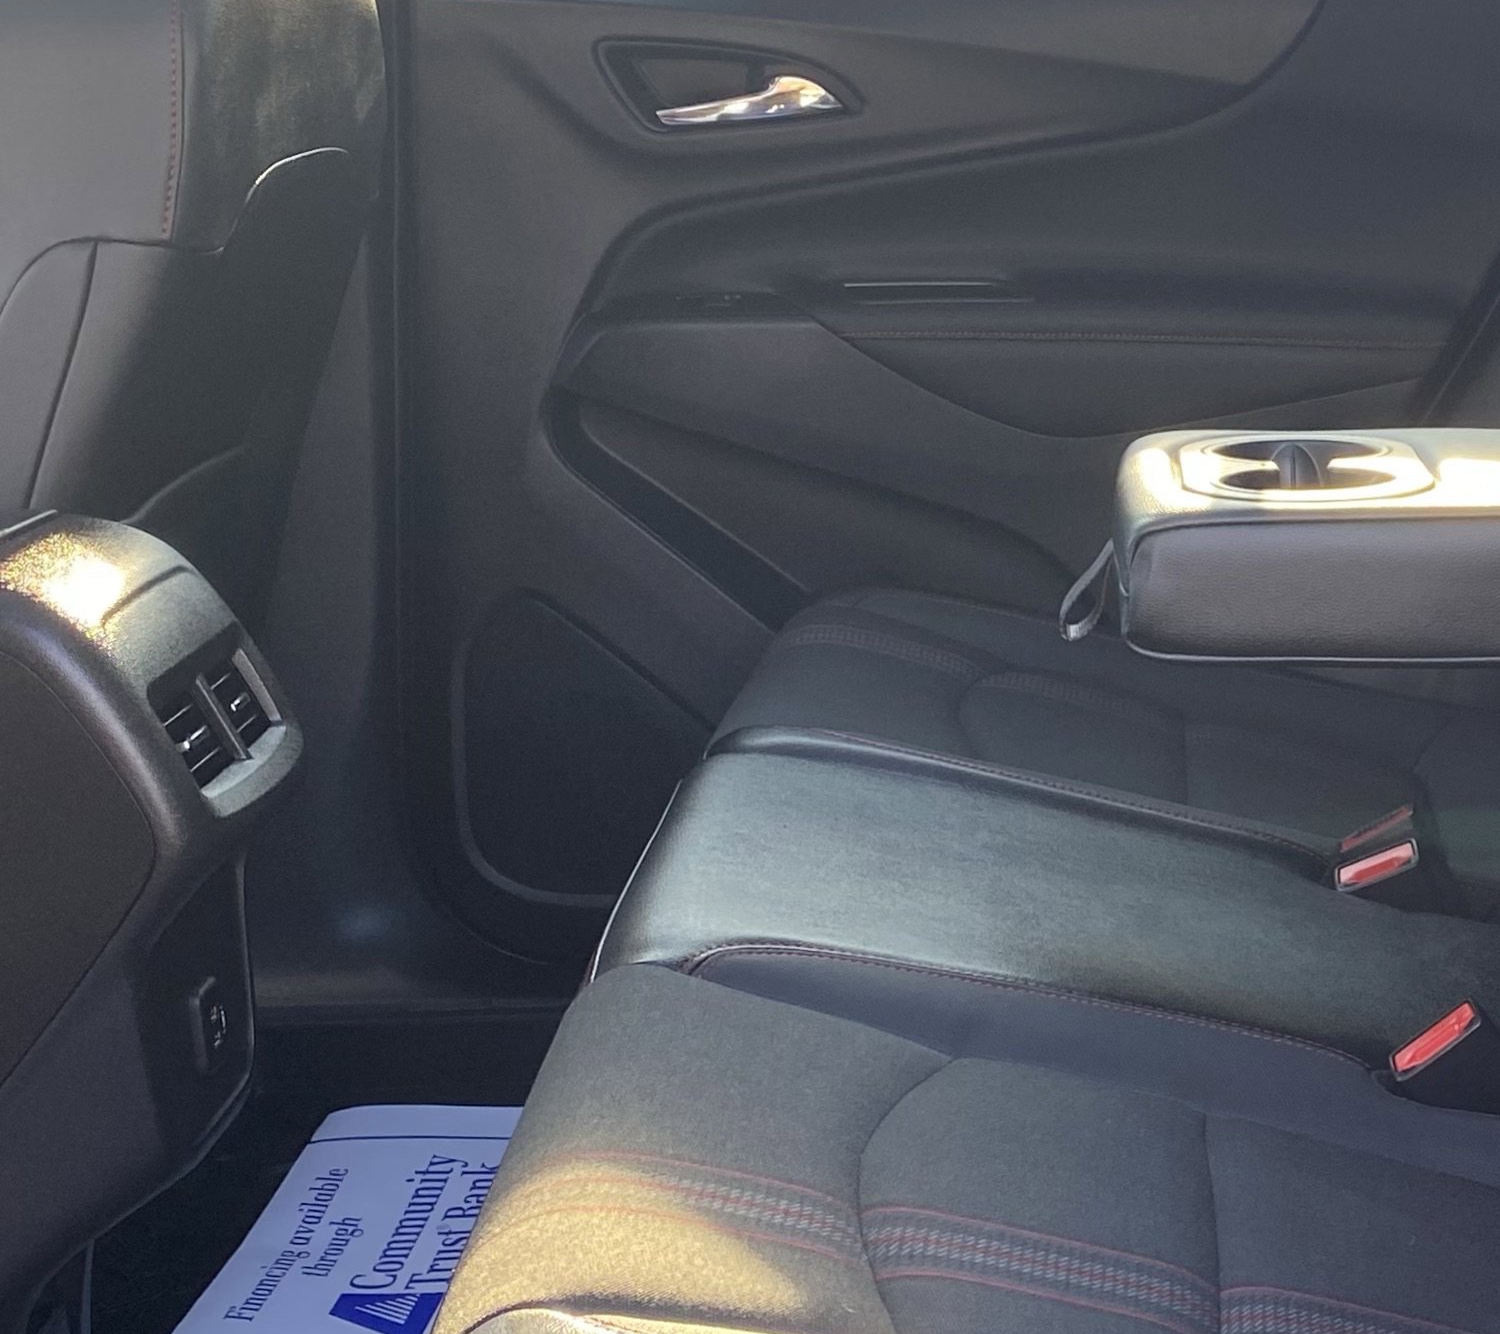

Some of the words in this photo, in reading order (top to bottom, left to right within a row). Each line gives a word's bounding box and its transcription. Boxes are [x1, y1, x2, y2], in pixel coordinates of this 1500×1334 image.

[223, 1249, 312, 1323] Financing
[289, 1167, 350, 1246] available
[301, 1216, 365, 1278] through
[349, 1154, 469, 1291] Community
[404, 1229, 473, 1291] Trust
[441, 1161, 501, 1221] Bank
